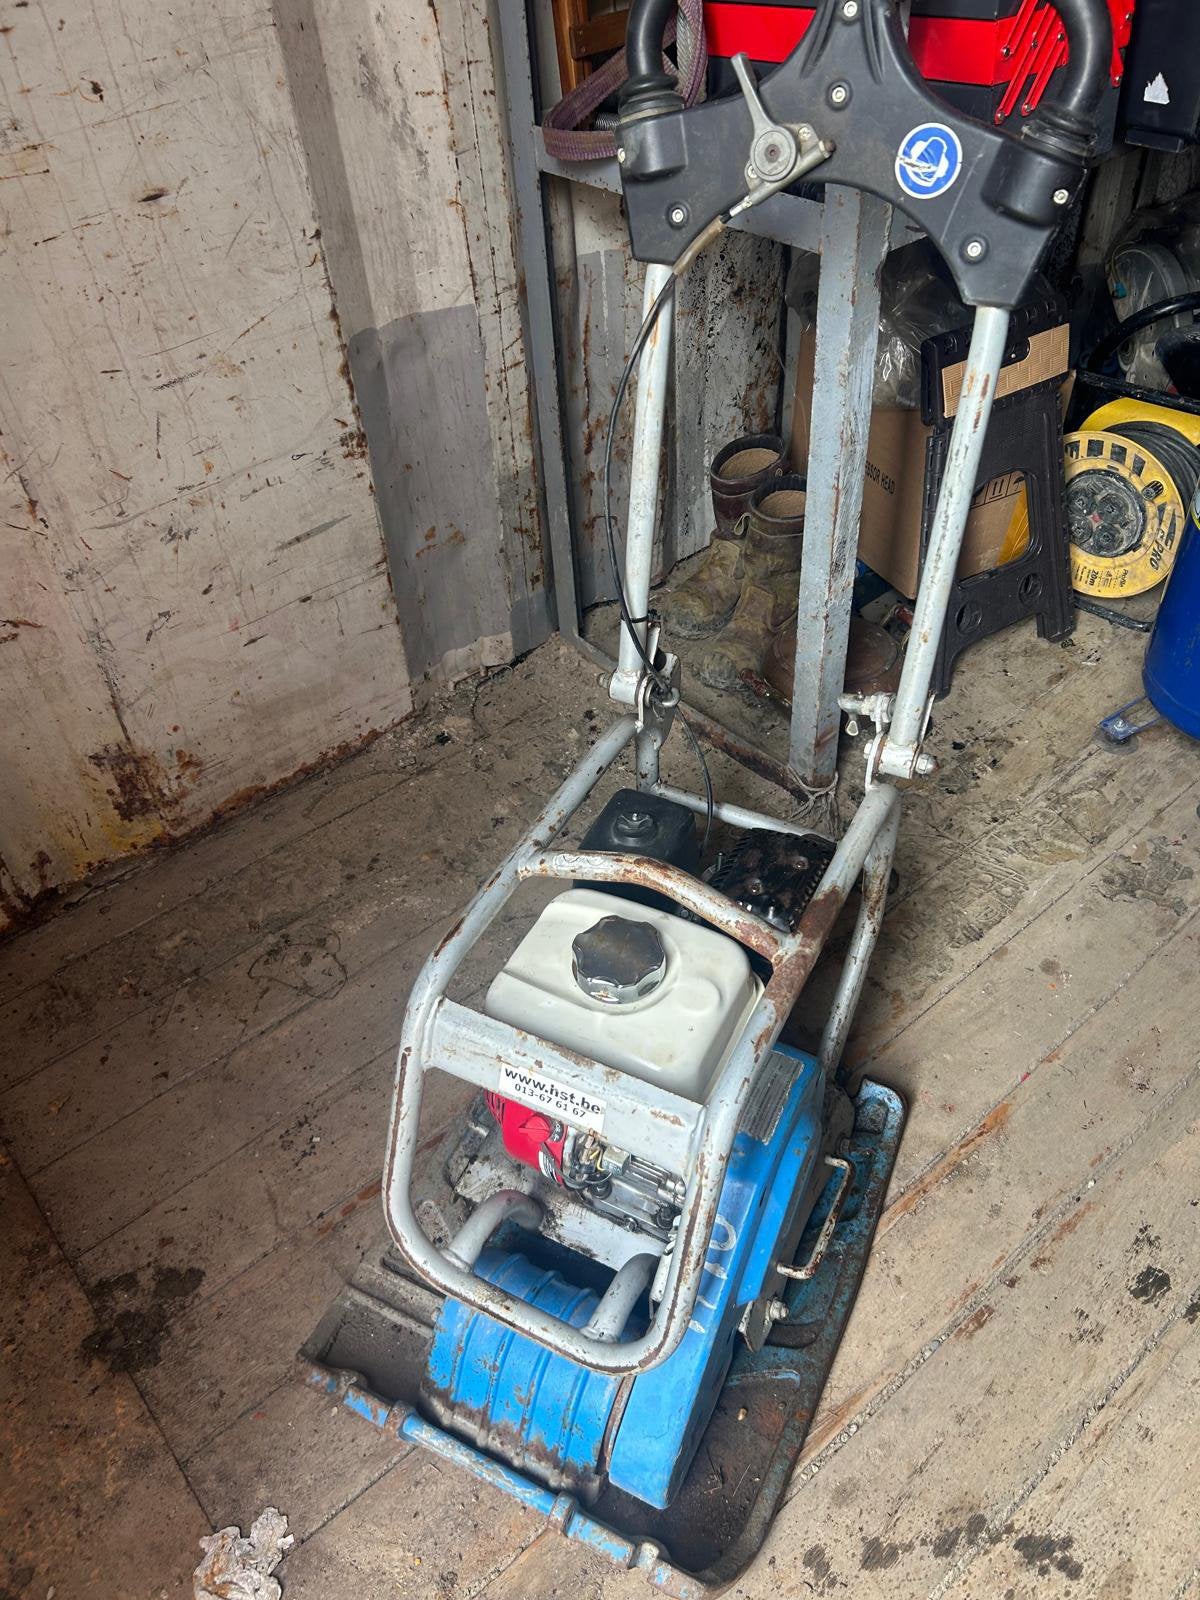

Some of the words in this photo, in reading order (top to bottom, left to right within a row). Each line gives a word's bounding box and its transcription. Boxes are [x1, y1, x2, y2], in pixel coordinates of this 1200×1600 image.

[514, 1083, 552, 1104] 013-67
[555, 1101, 568, 1111] 61
[572, 1107, 586, 1118] 67
